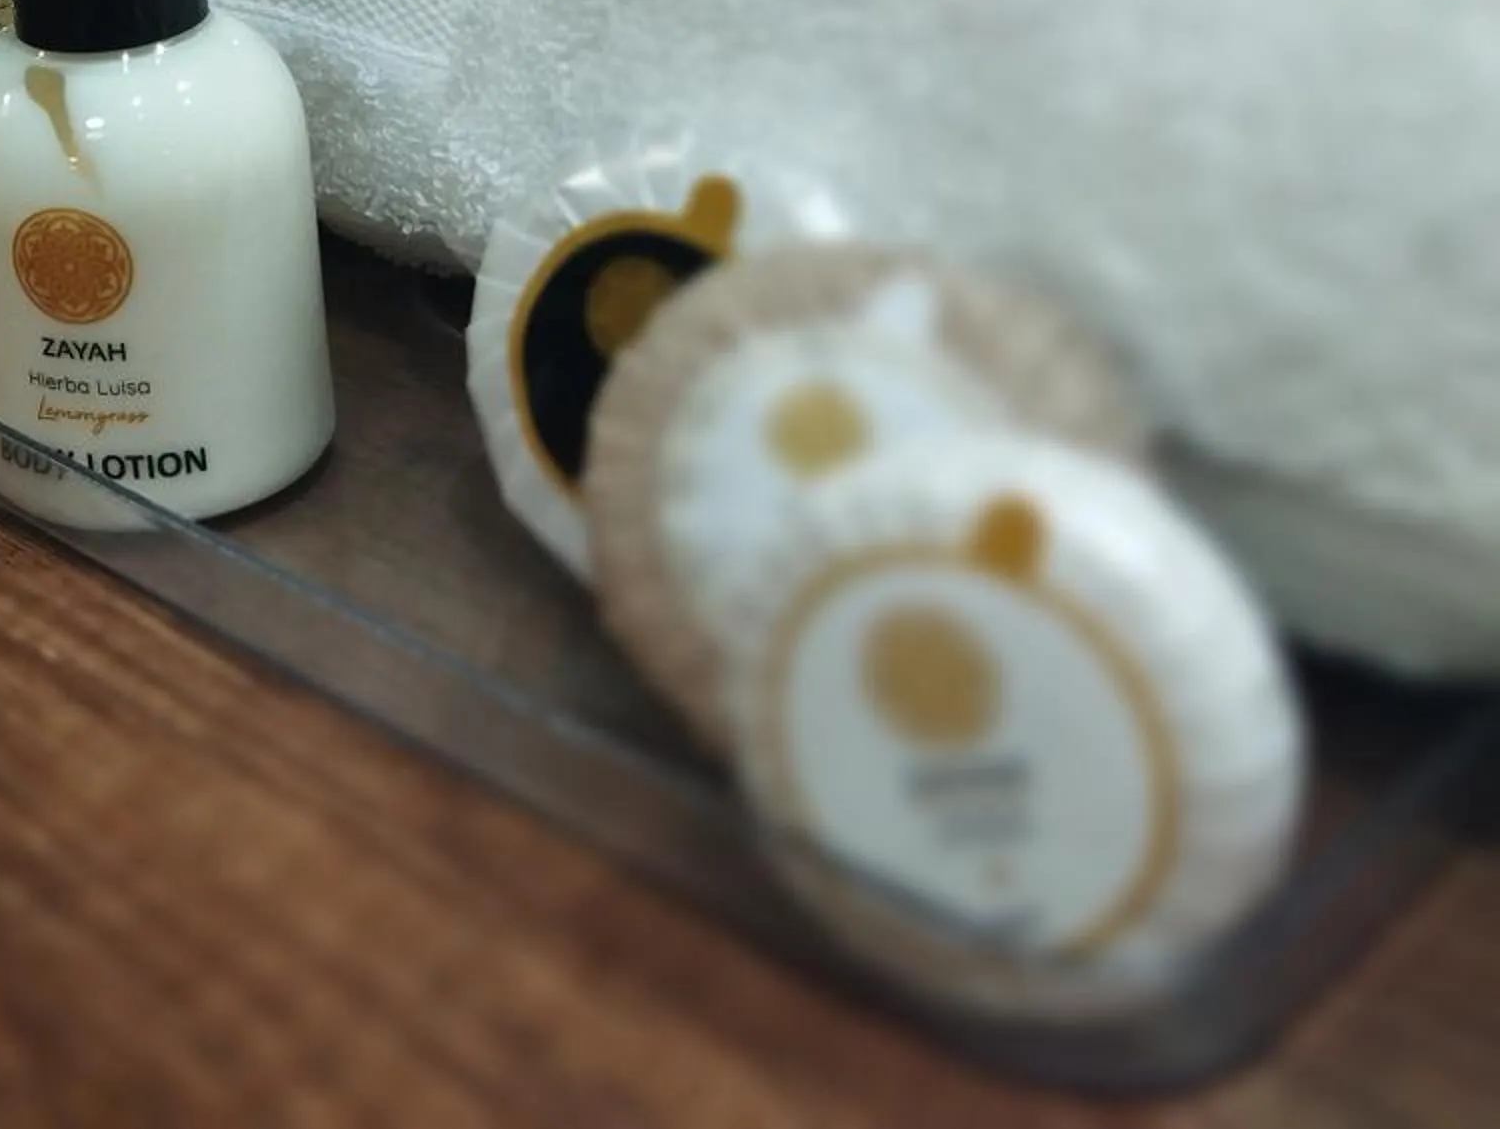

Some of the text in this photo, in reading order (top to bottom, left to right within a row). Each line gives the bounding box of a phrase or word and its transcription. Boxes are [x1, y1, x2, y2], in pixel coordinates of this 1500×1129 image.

[41, 337, 127, 361] ZAYAH
[29, 370, 151, 396] Hierba Luisa
[37, 396, 149, 435] Lemongrass
